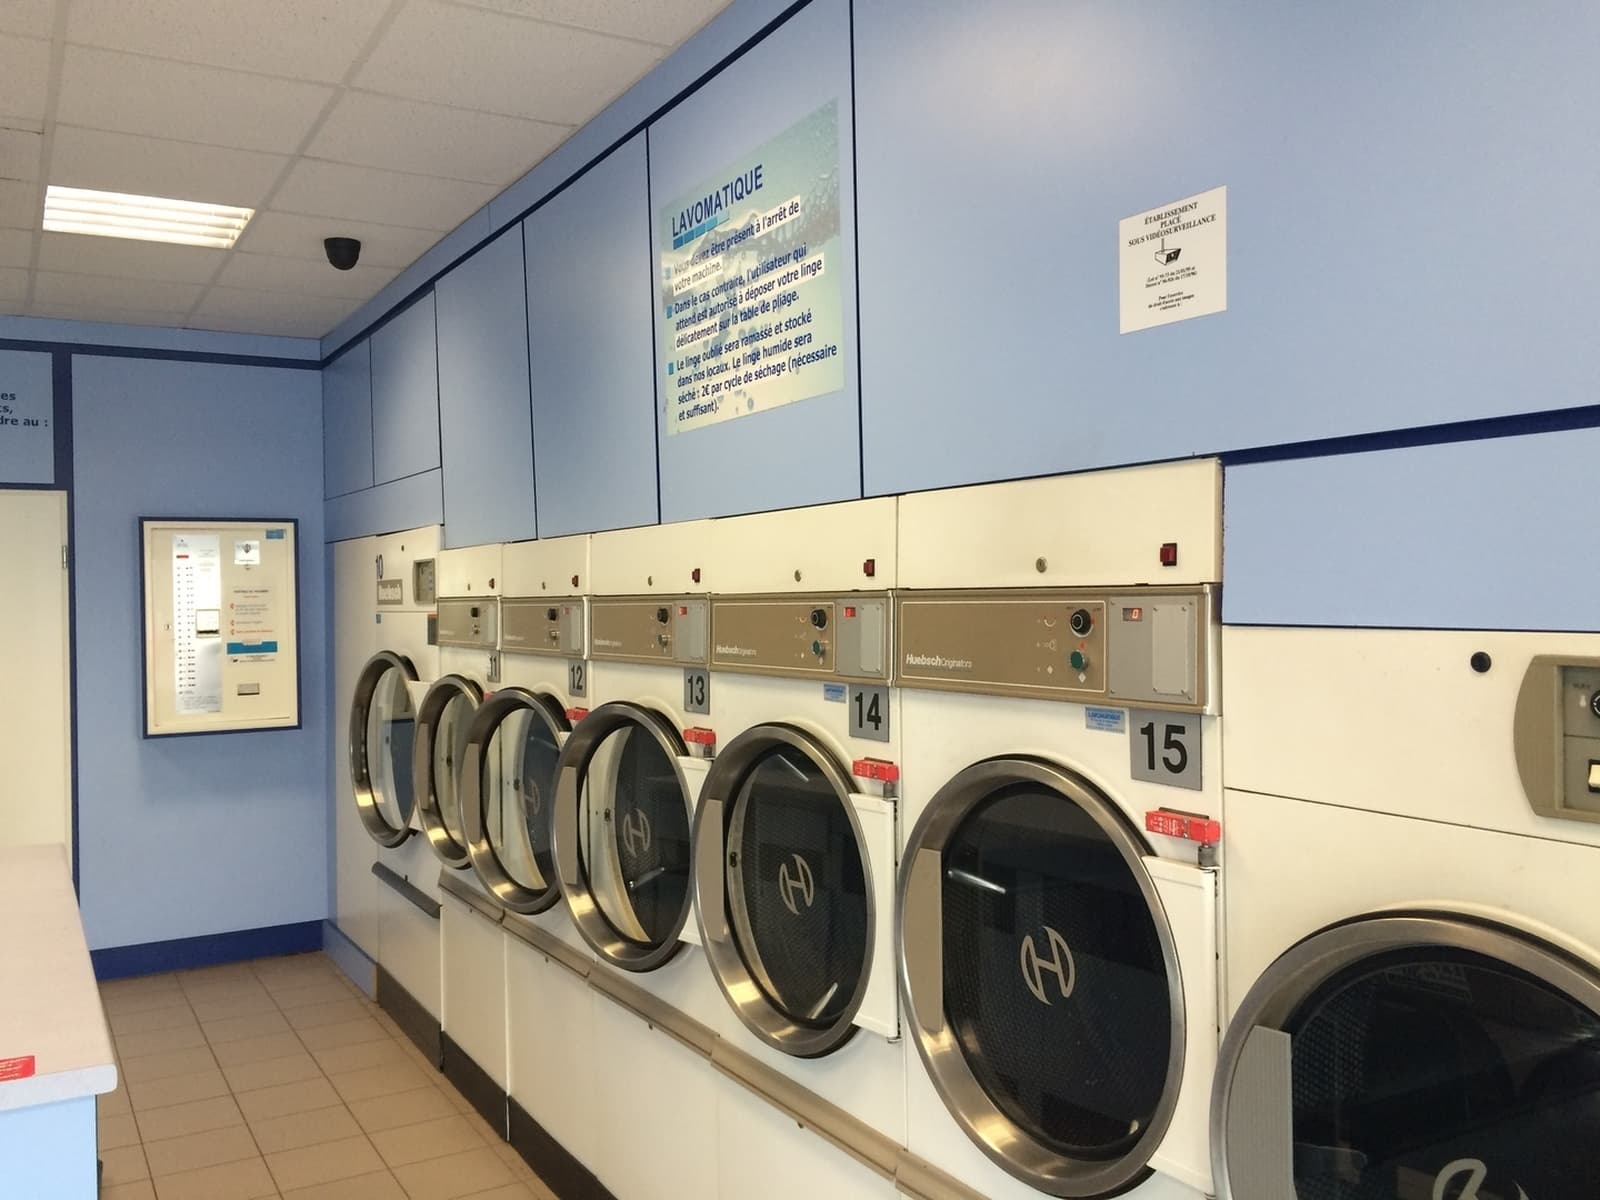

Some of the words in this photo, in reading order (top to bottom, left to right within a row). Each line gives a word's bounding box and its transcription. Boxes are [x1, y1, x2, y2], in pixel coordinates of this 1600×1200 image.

[672, 164, 763, 237] LAVOMATIQUE
[711, 241, 725, 256] être
[726, 223, 755, 251] présent
[755, 219, 761, 233] à
[762, 206, 787, 230] l'arrêt
[788, 200, 800, 216] de
[674, 276, 691, 292] votre
[692, 262, 722, 282] machine.
[674, 300, 691, 314] Dans
[691, 295, 698, 306] le
[699, 290, 710, 303] cas
[711, 275, 745, 298] contraire,
[747, 253, 792, 282] l'utilisateur
[793, 241, 807, 263] qui
[675, 312, 696, 331] attend
[697, 308, 708, 321] est
[738, 290, 743, 304] à
[745, 280, 776, 302] déposer
[777, 269, 799, 288] votre
[800, 259, 822, 277] linge
[676, 321, 718, 349] délicatement
[719, 317, 731, 331] sur
[732, 312, 739, 325] la
[740, 304, 759, 322] table
[760, 299, 770, 314] de
[772, 290, 799, 313] pliage.
[676, 360, 684, 371] Le
[685, 354, 701, 369] linge
[702, 344, 723, 361] oublié
[724, 340, 740, 354] sera
[740, 323, 773, 347] ramassé
[774, 321, 783, 334] et
[784, 308, 812, 331] stocké
[677, 374, 692, 388] dans
[693, 370, 705, 382] nos
[706, 361, 731, 378] locaux.
[732, 356, 741, 369] Le
[742, 350, 761, 366] linge
[762, 338, 793, 359] humide
[794, 332, 812, 348] sera
[701, 383, 710, 397] 2€
[711, 380, 722, 397] par
[724, 374, 742, 392] cycle
[743, 370, 753, 384] de
[754, 361, 786, 380] séchage
[788, 344, 837, 373] (nécessaire
[23, 418, 39, 427] au
[678, 409, 685, 421] et
[686, 398, 719, 420] suffisant).
[489, 655, 497, 677] 11
[571, 664, 583, 690] 12
[687, 675, 705, 706] 13
[855, 692, 882, 731] 14
[1140, 721, 1187, 774] 15
